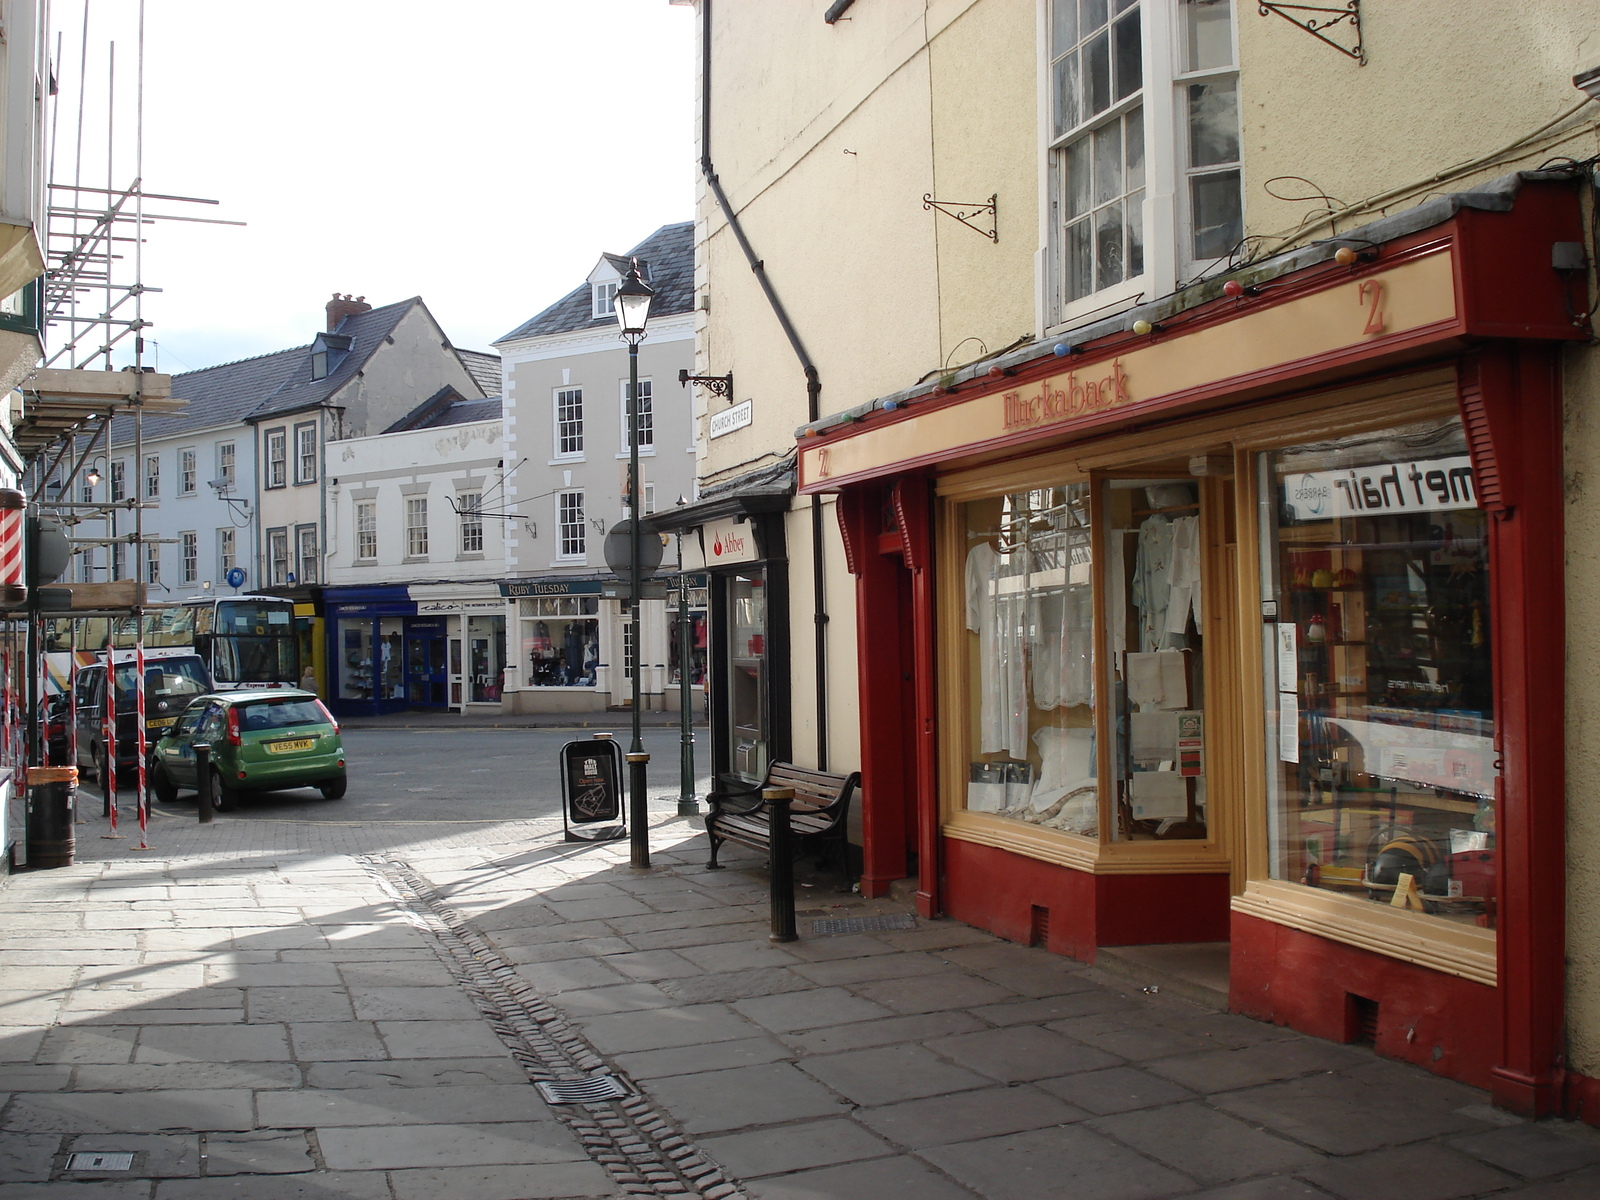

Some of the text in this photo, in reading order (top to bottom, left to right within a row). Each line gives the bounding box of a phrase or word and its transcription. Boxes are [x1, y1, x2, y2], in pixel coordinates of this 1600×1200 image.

[1359, 278, 1386, 336] 2
[1002, 357, 1130, 430] Huckaback
[712, 406, 750, 432] CHURCH STREET
[818, 448, 832, 477] 2
[724, 532, 745, 556] Abbey
[508, 583, 570, 596] RUBY TUESDAY
[667, 576, 698, 588] TUAY
[273, 742, 293, 751] VE55
